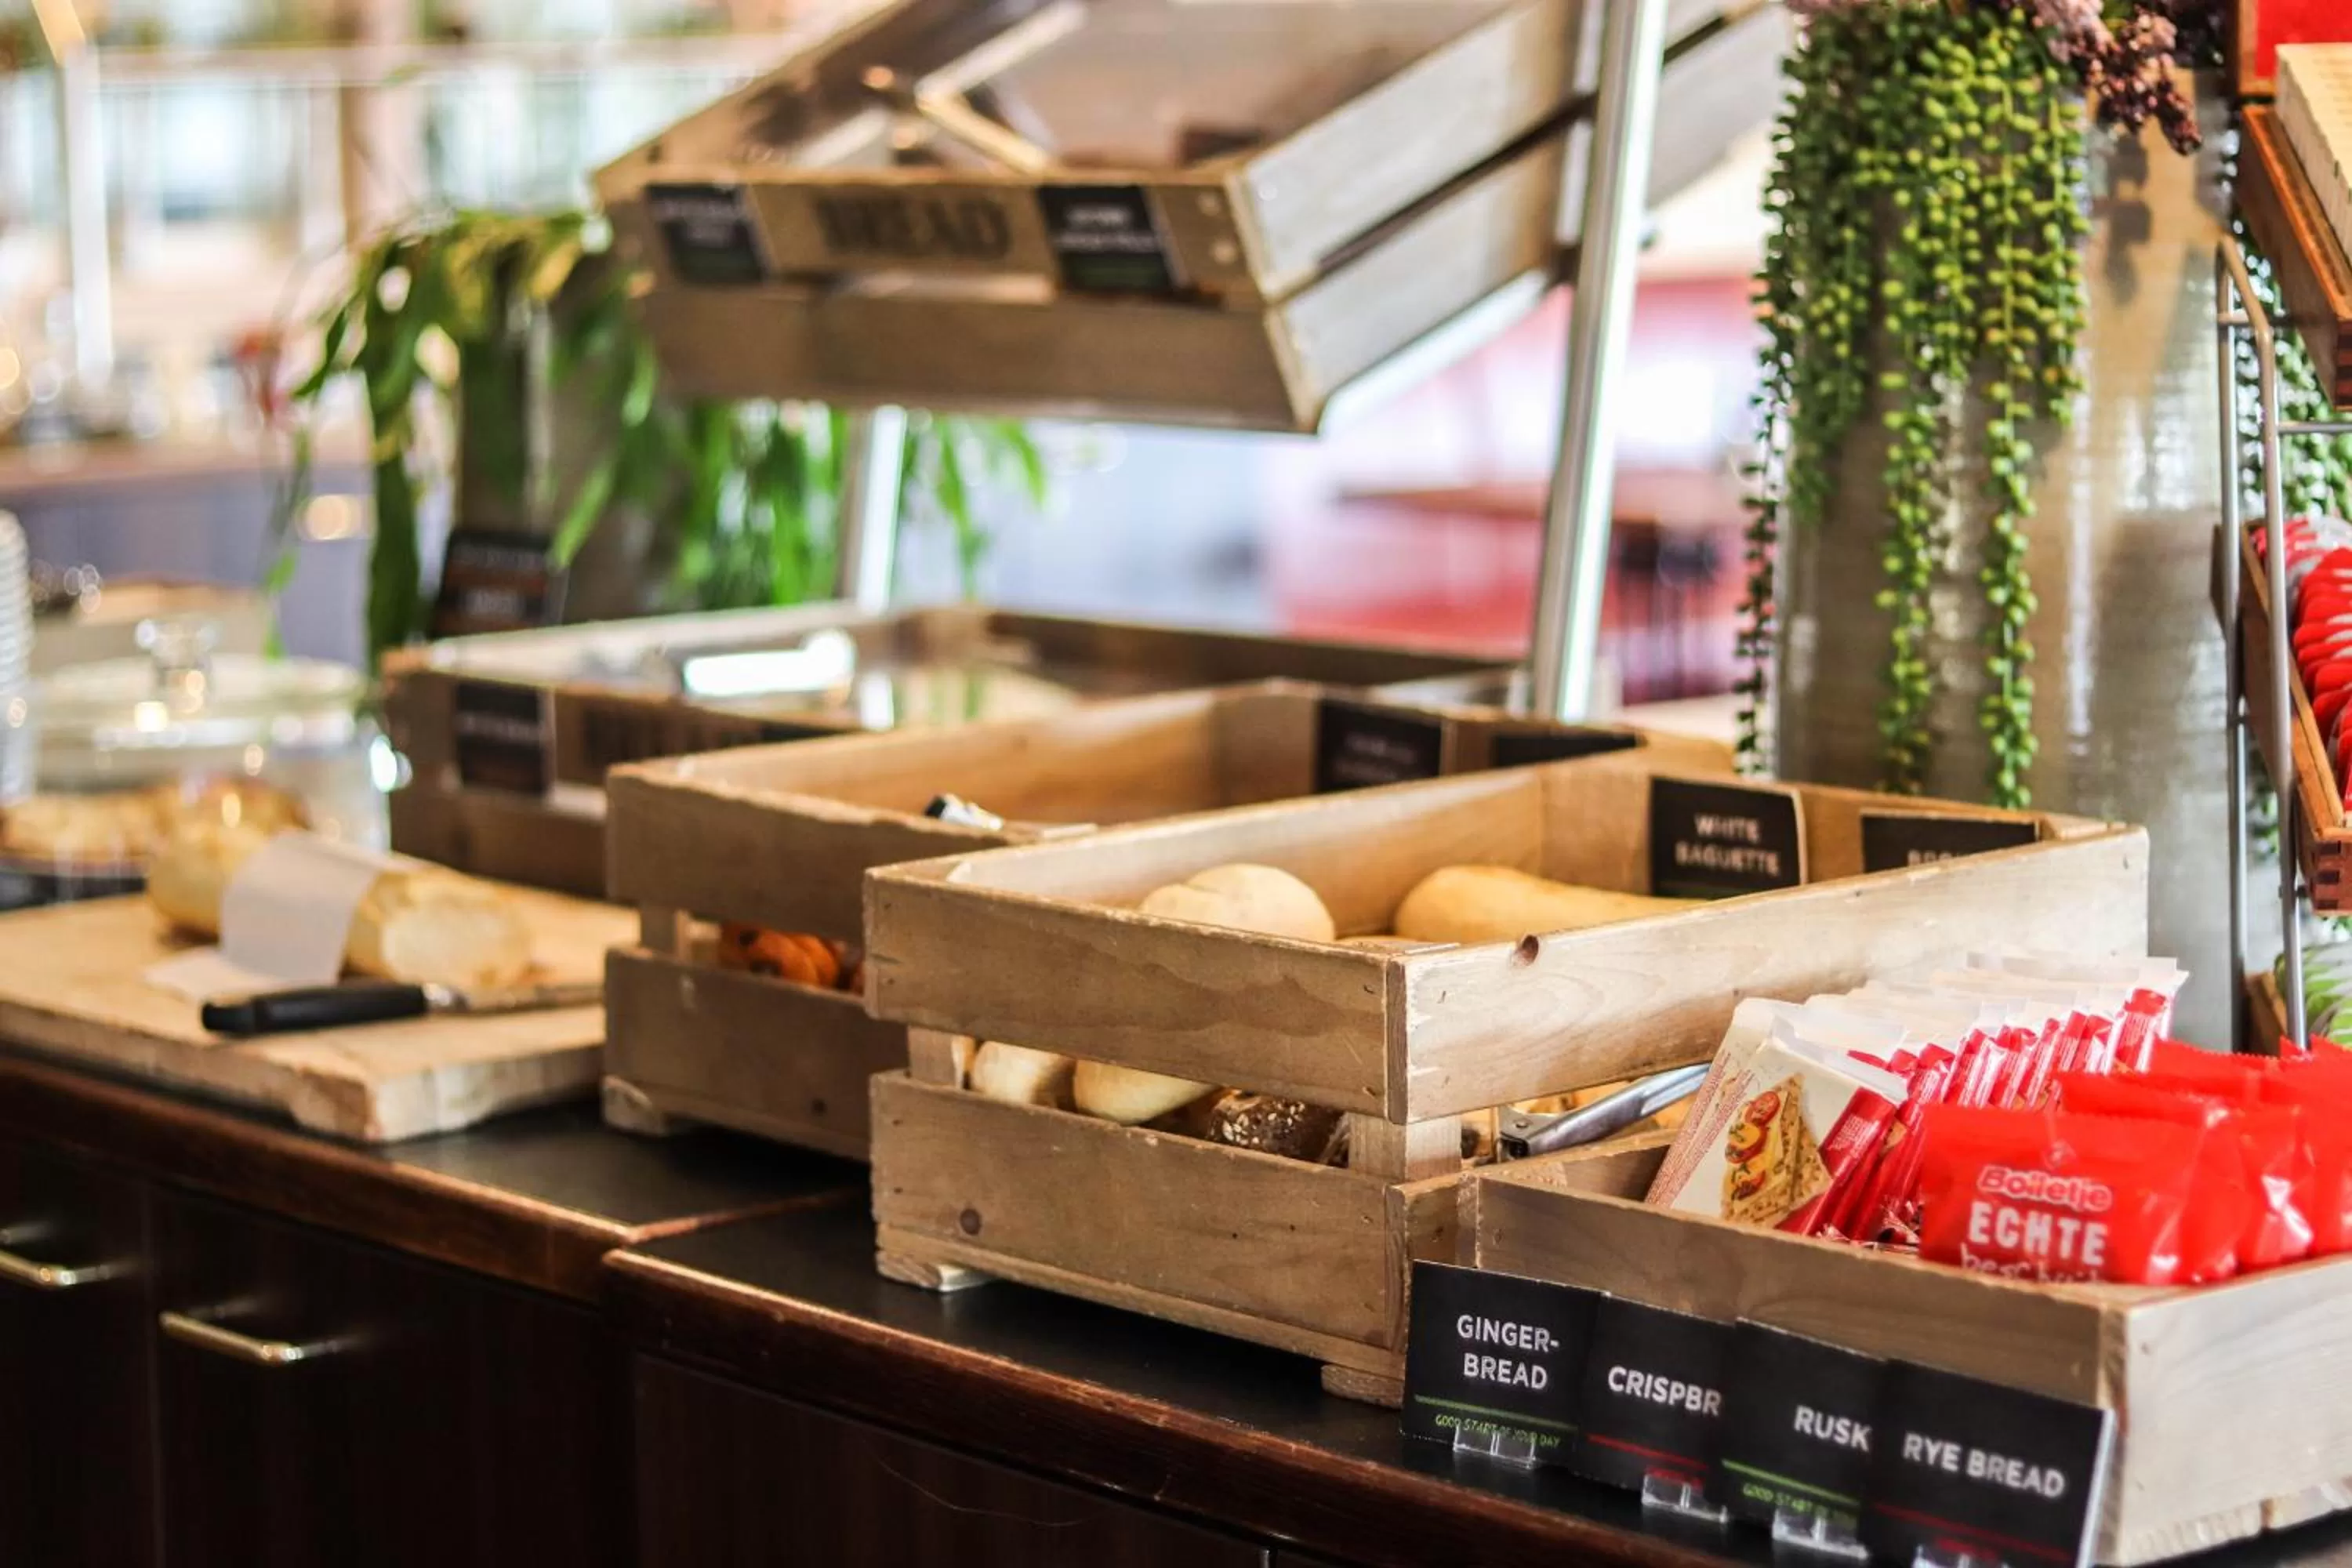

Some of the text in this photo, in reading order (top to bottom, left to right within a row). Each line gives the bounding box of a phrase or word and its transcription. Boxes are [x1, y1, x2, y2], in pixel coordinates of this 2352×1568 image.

[1694, 813, 1761, 844] WHITE
[1675, 840, 1779, 878] BAGUETTE
[1968, 1200, 2109, 1267] ECHTE
[1456, 1314, 1560, 1352] GINGER-
[1463, 1352, 1548, 1390] BREAD
[1607, 1365, 1722, 1417] CRISPBR
[1436, 1414, 1461, 1428] GOOD
[1463, 1417, 1497, 1435] START
[1539, 1432, 1561, 1447] DAY
[1793, 1404, 1872, 1453] RUSK
[1903, 1432, 2066, 1498] RYE BREAD
